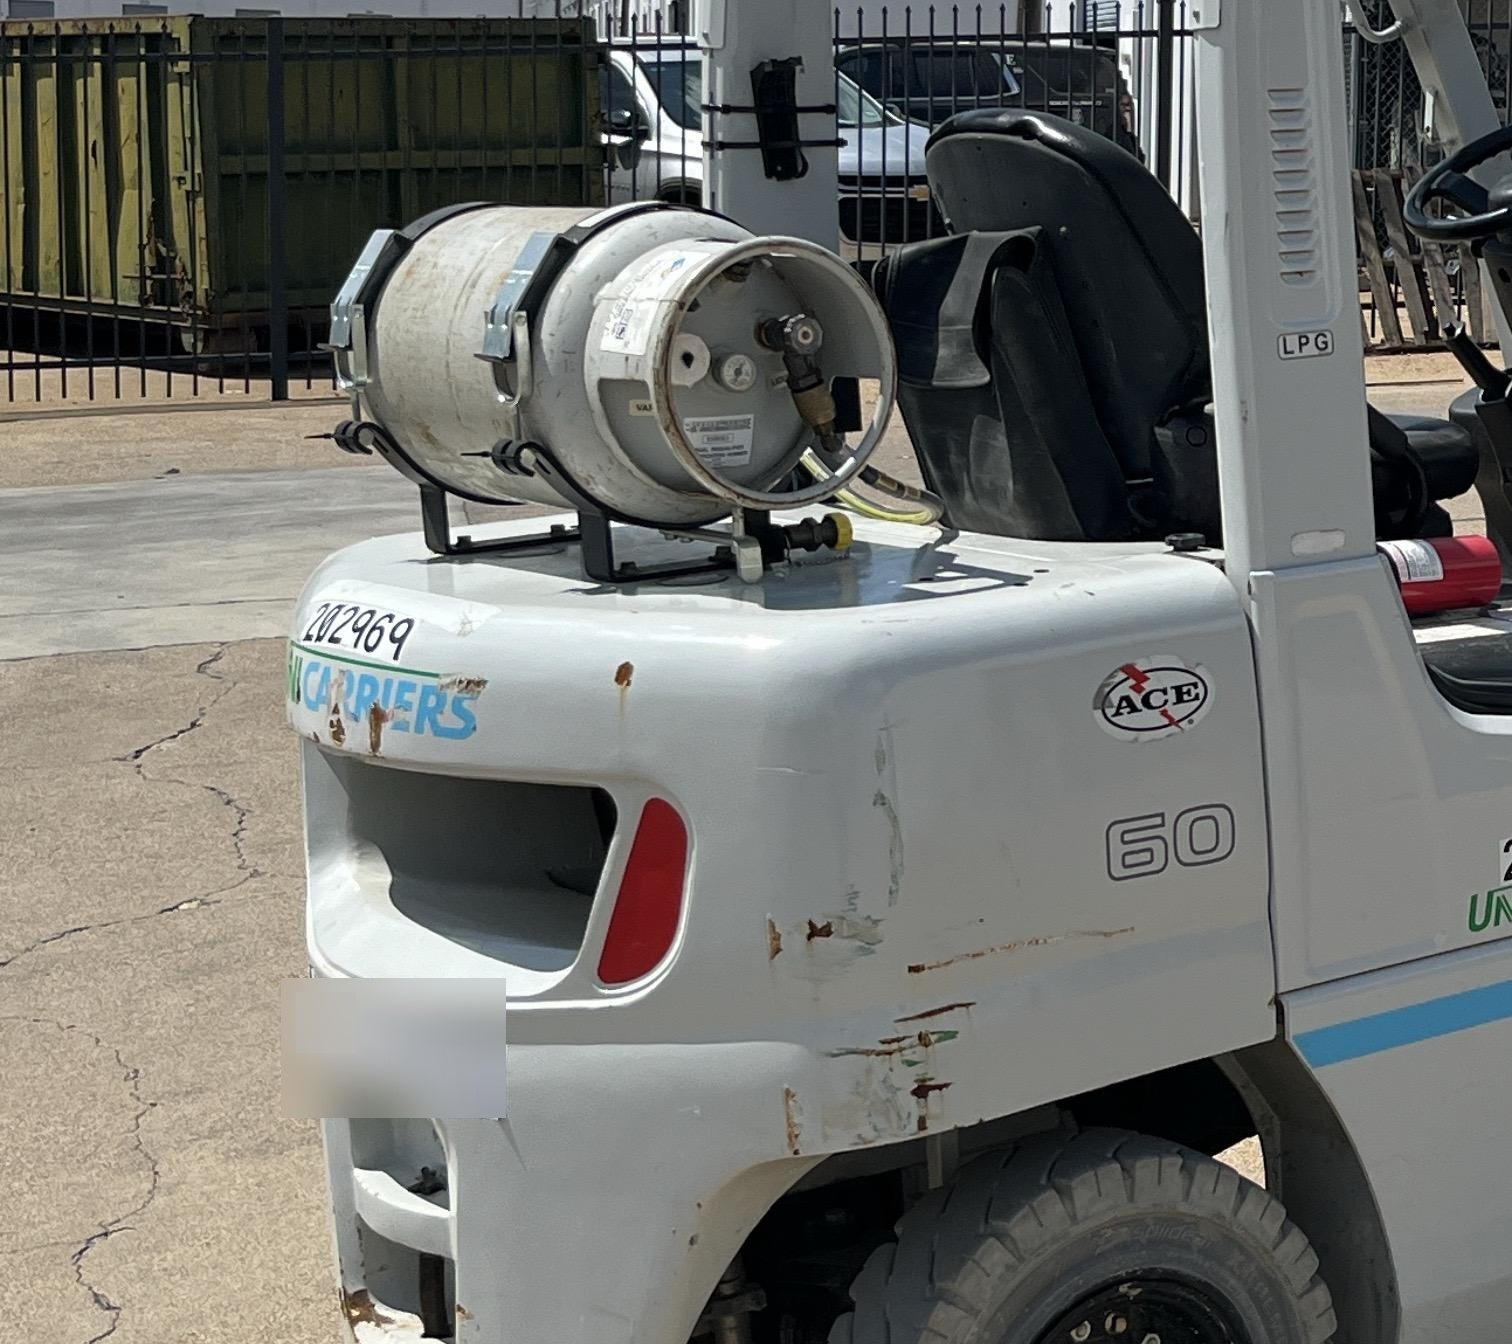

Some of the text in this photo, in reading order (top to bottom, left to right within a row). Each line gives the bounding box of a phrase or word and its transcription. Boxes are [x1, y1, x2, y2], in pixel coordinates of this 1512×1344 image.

[1282, 332, 1329, 355] LPG
[302, 601, 416, 662] 202969
[1111, 681, 1201, 718] ACE
[1106, 803, 1236, 882] 60
